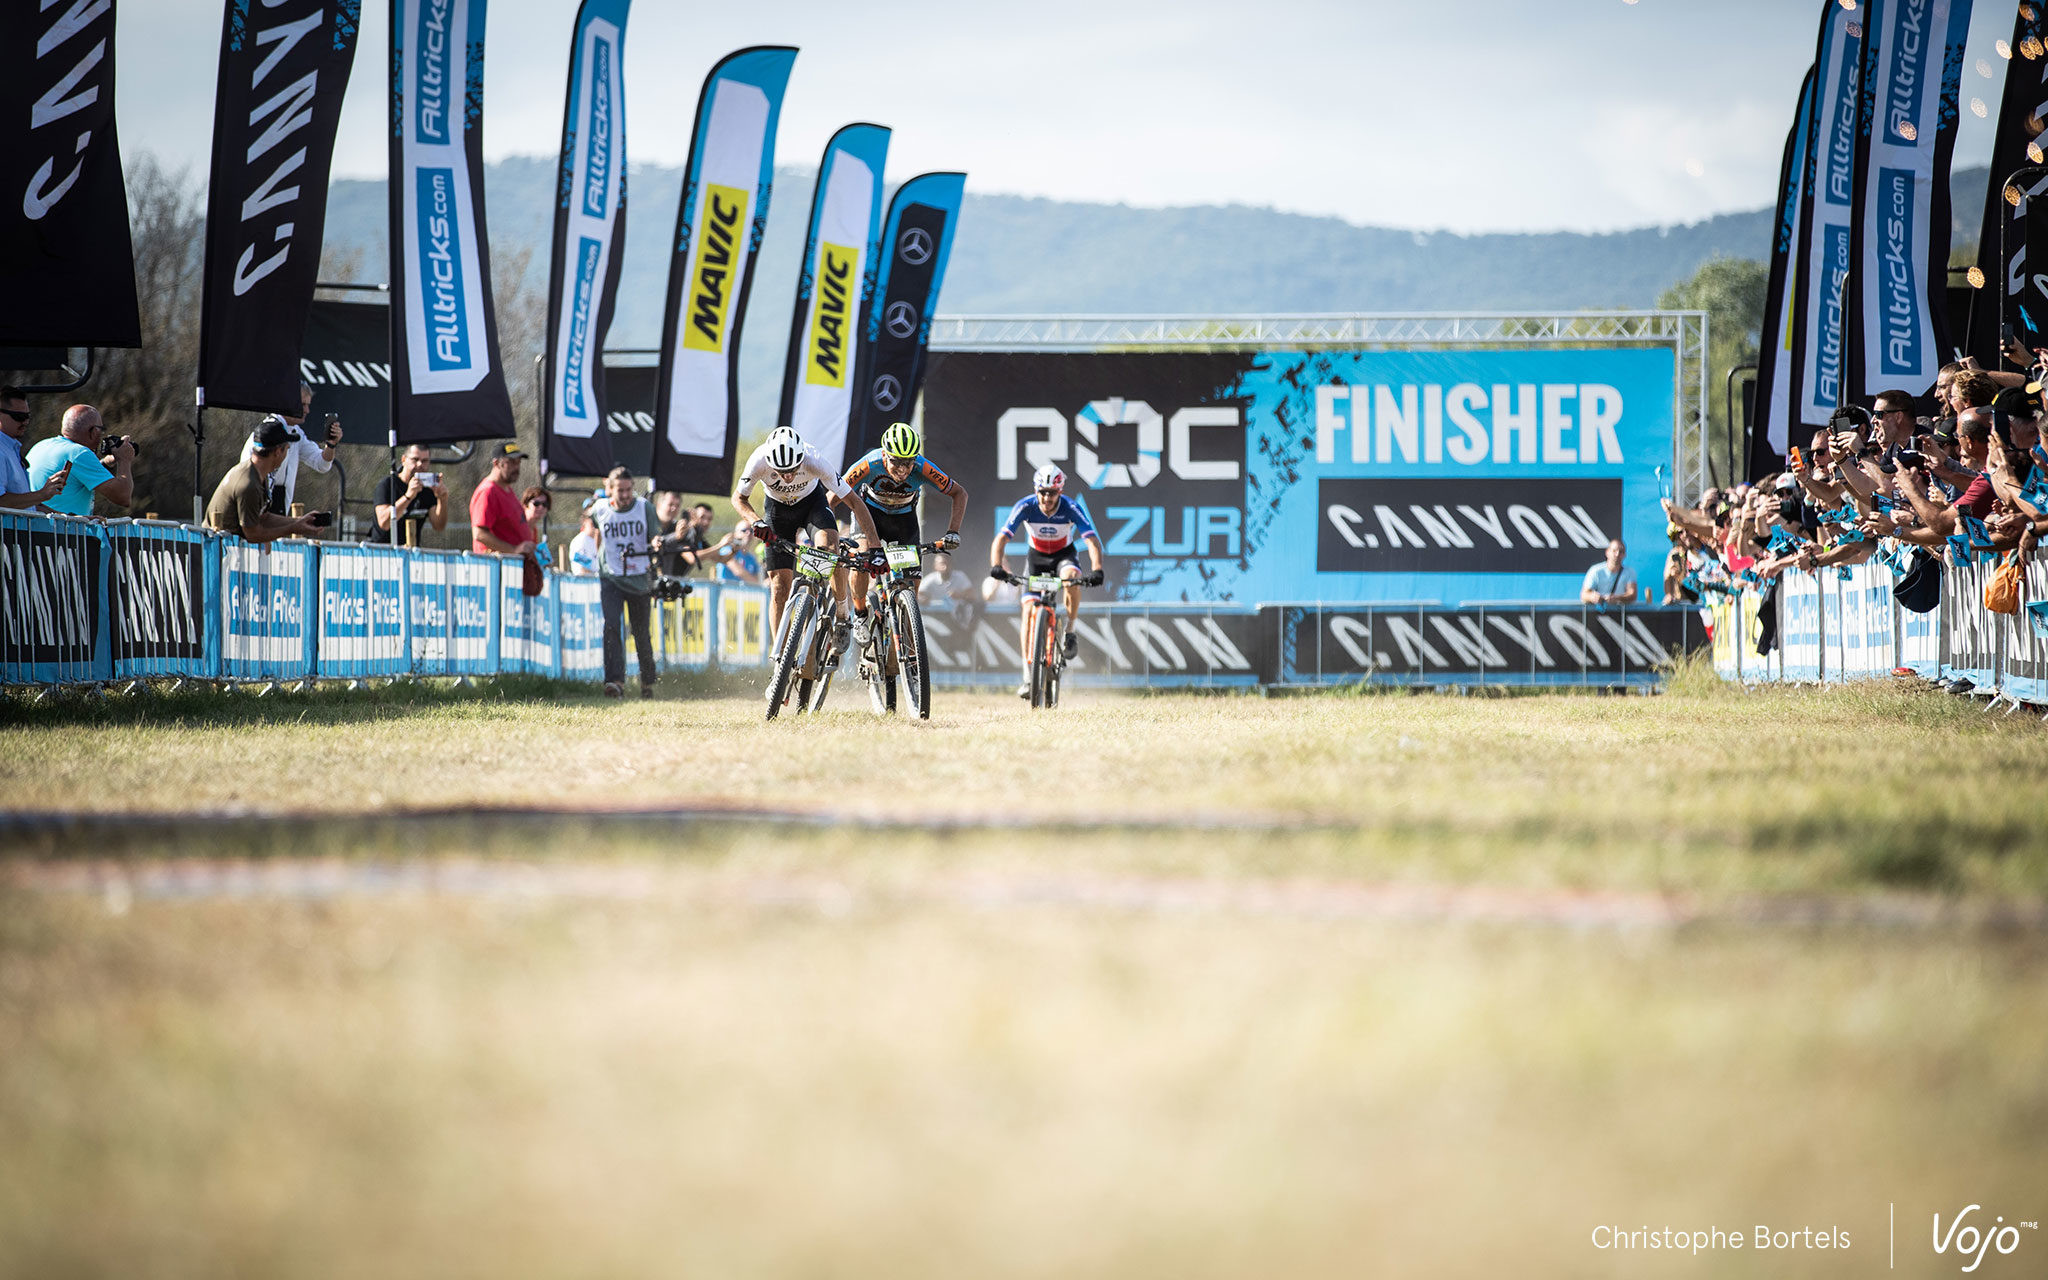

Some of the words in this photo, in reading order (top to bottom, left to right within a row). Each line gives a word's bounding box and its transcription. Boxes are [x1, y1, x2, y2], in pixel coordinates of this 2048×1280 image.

[234, 0, 324, 296] CANY
[428, 174, 462, 363] Alltricks.com
[693, 192, 738, 343] MAVIC
[816, 250, 849, 380] MAVIC
[1885, 176, 1912, 368] Alltricks.com
[997, 397, 1240, 490] ROC
[1315, 383, 1624, 465] FINISHER
[604, 520, 643, 538] PHOTO
